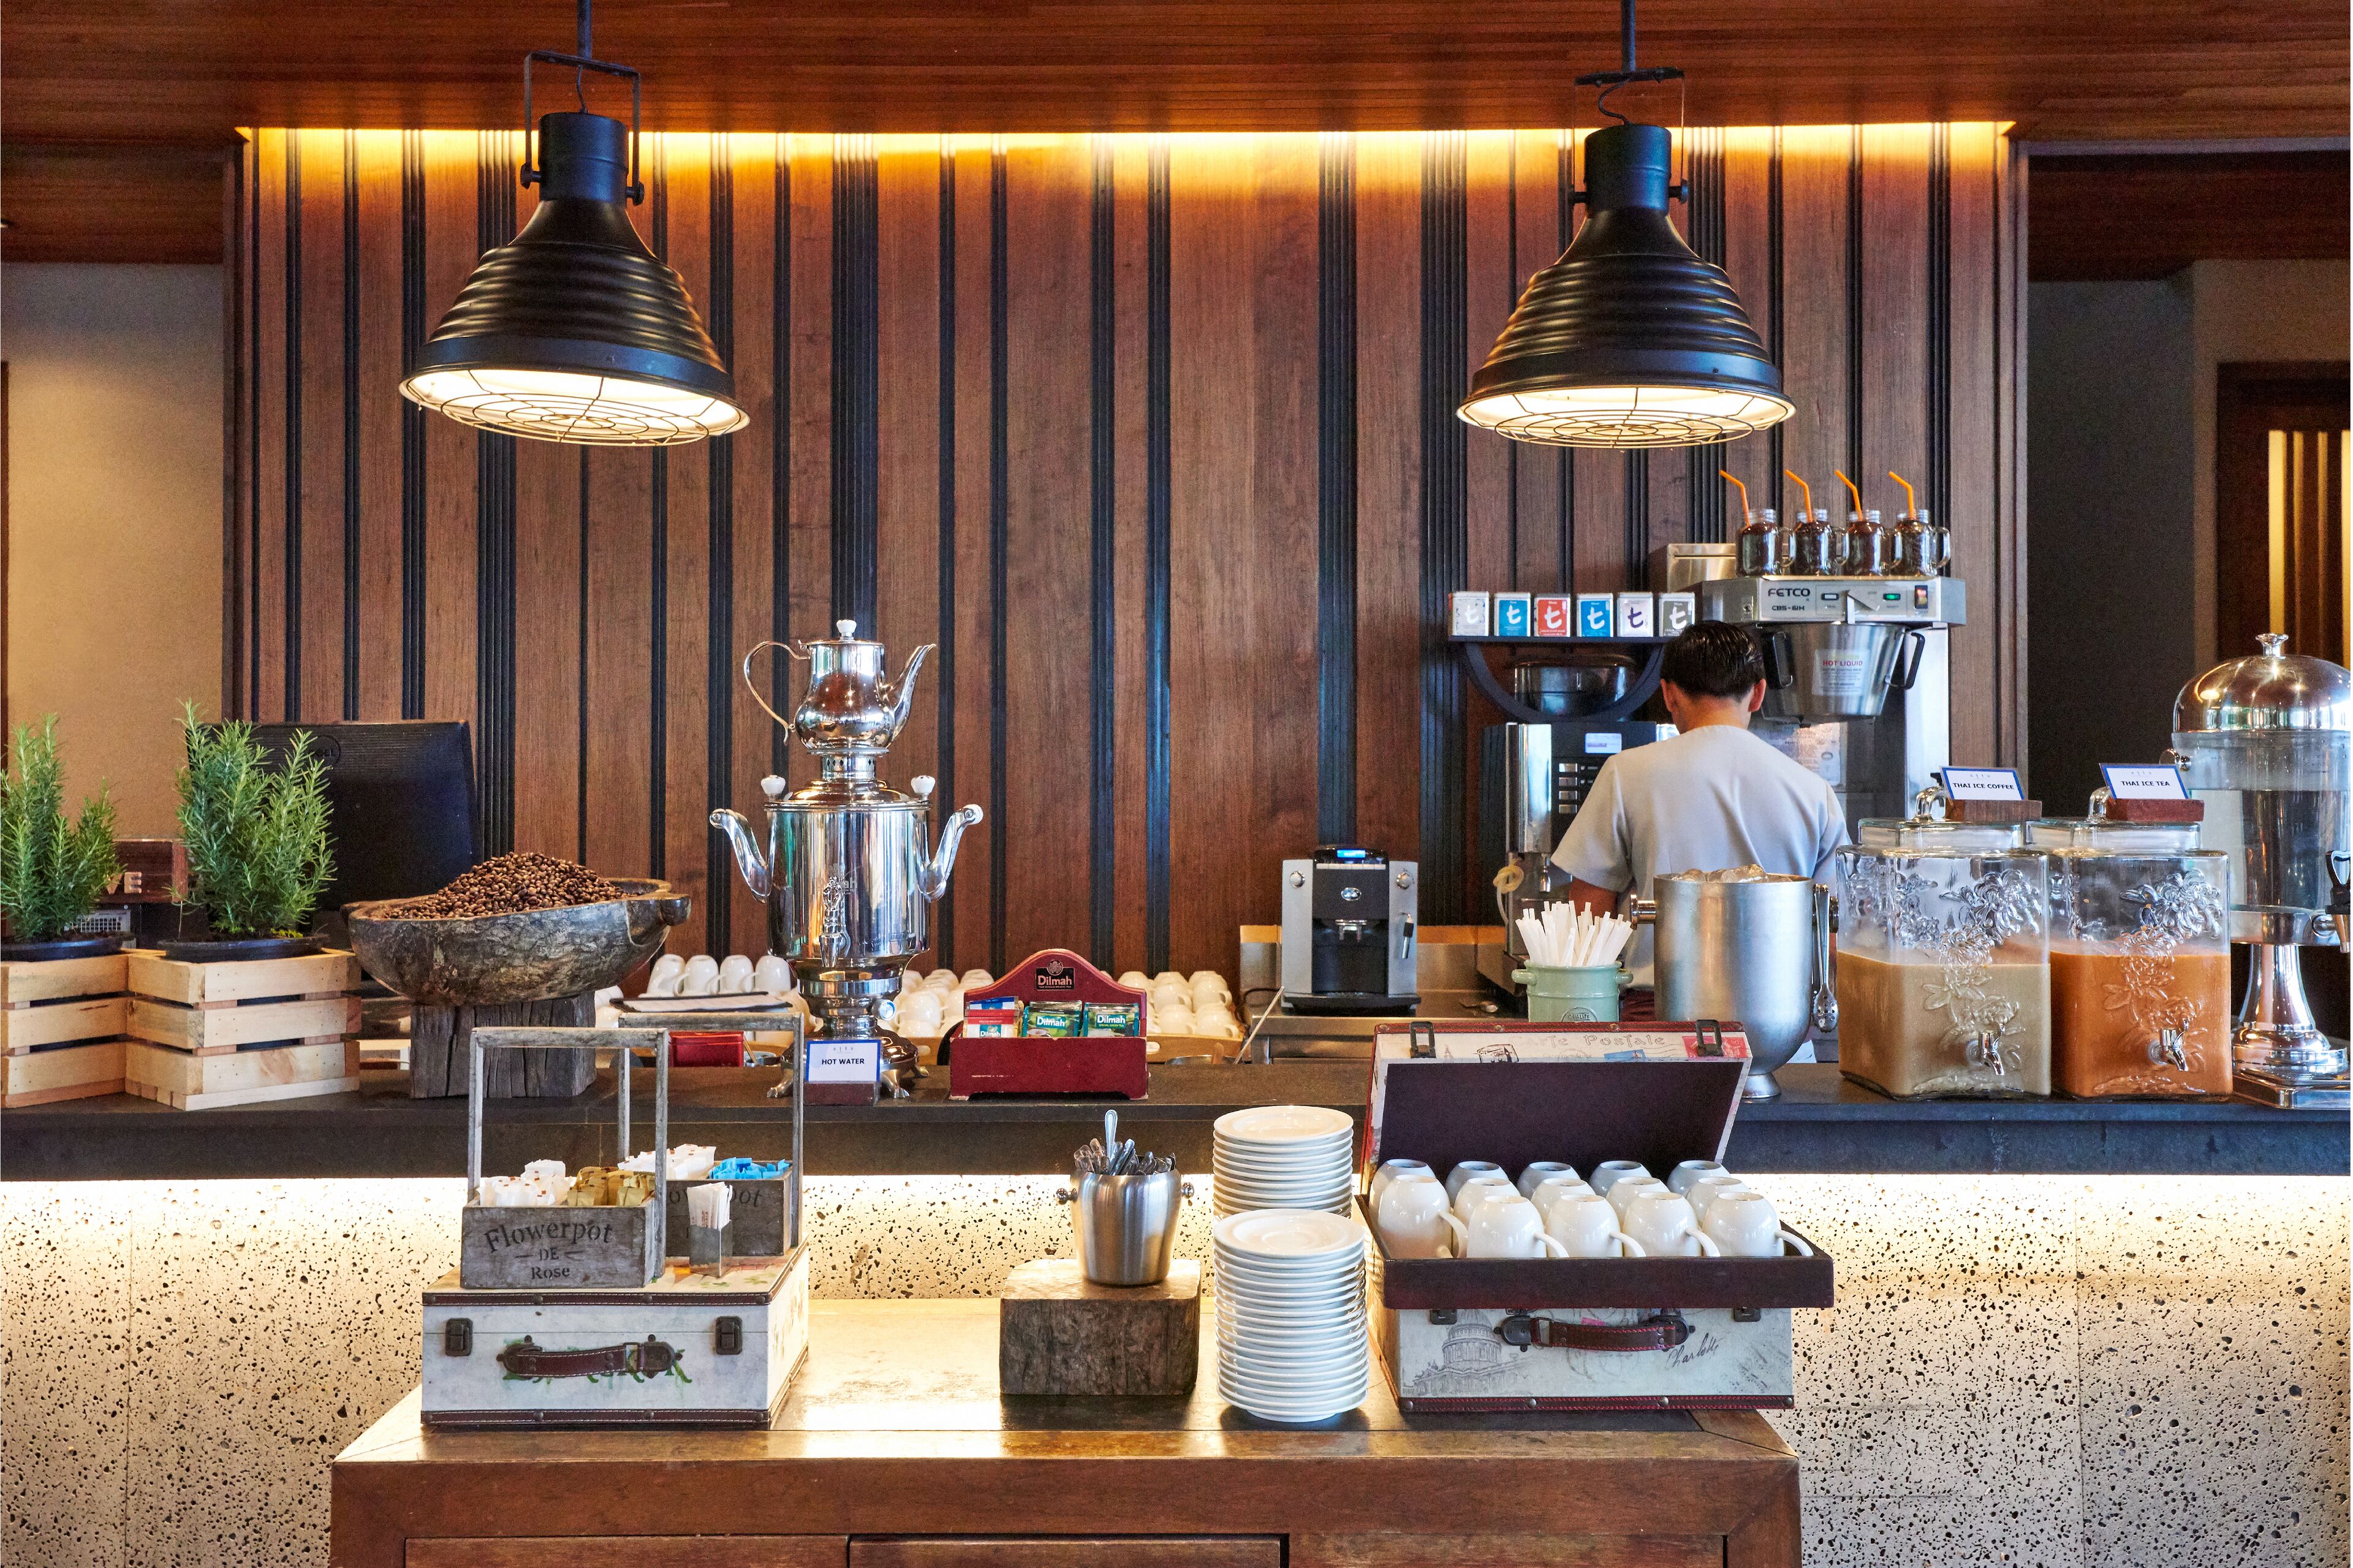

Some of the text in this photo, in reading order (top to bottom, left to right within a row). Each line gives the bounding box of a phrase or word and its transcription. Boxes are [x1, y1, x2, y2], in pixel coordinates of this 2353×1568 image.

[1768, 588, 1811, 597] FETCO
[1037, 975, 1072, 985] Dilmah
[1036, 1016, 1065, 1026] Dilmah
[1097, 1015, 1126, 1023] Dilmah
[483, 1222, 613, 1253] Flowerpot
[539, 1247, 559, 1261] DE
[531, 1267, 570, 1279] Rose
